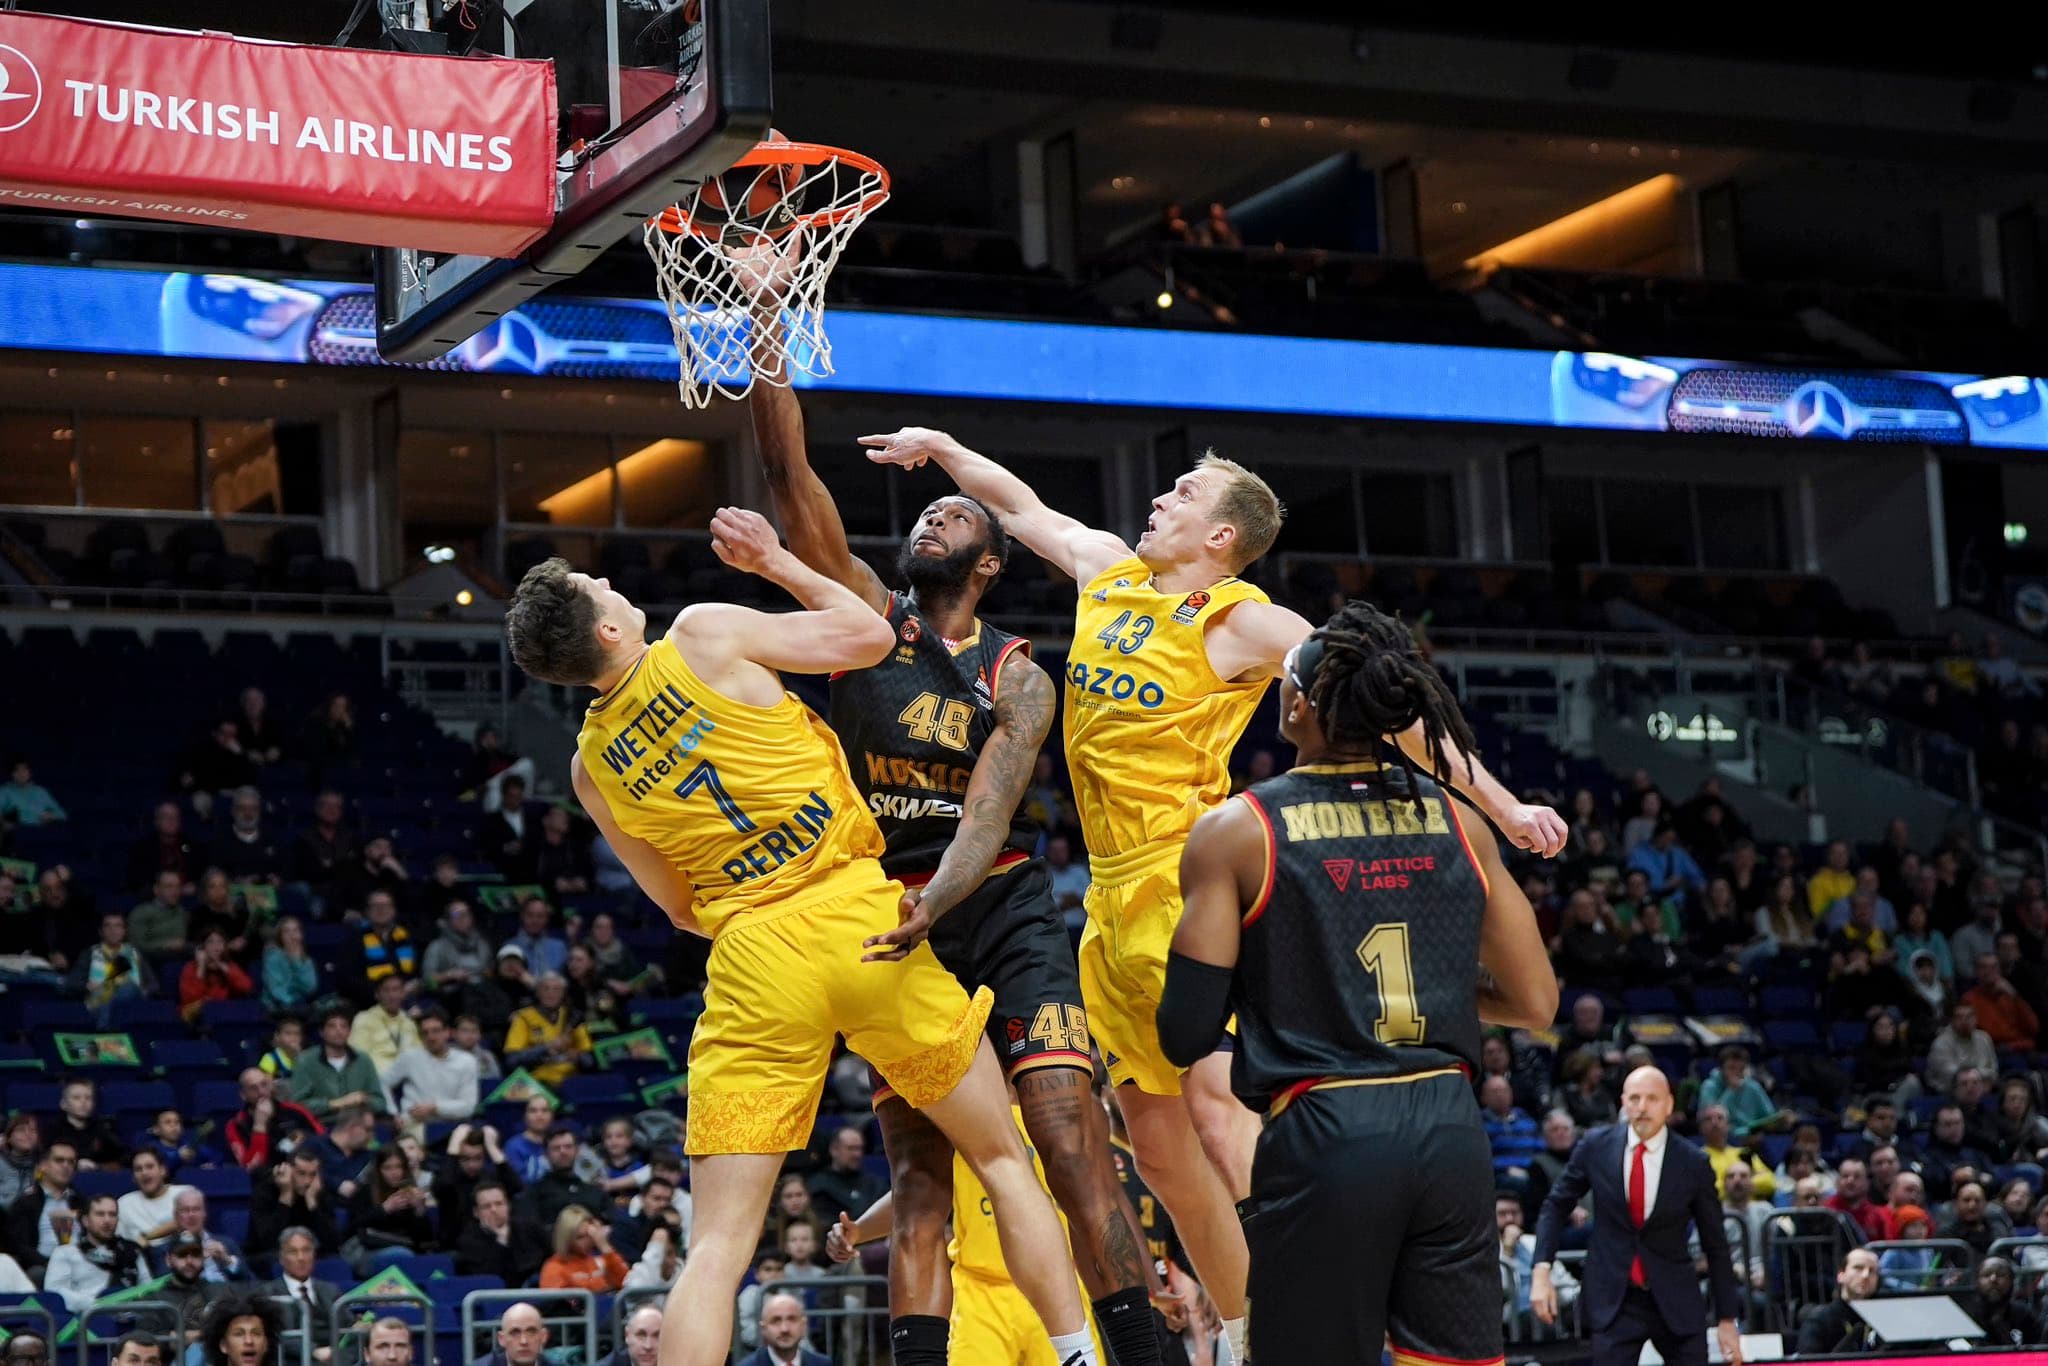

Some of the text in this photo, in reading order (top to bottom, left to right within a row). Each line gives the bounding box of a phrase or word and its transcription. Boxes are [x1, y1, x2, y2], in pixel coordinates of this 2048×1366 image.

[64, 79, 513, 173] TURKISH AIRLINES
[0, 188, 249, 221] TURKISH AIRLINES
[1097, 610, 1155, 655] 43
[601, 684, 695, 776] WETZELL
[898, 691, 976, 751] 45
[673, 758, 758, 833] 7
[864, 750, 972, 796] MONAC
[722, 790, 834, 883] BERLIN
[1280, 797, 1450, 843] MONEKE
[1359, 856, 1435, 875] LATTICE
[1361, 874, 1409, 890] LABS
[1355, 922, 1426, 1047] 1
[1028, 1002, 1091, 1055] 45
